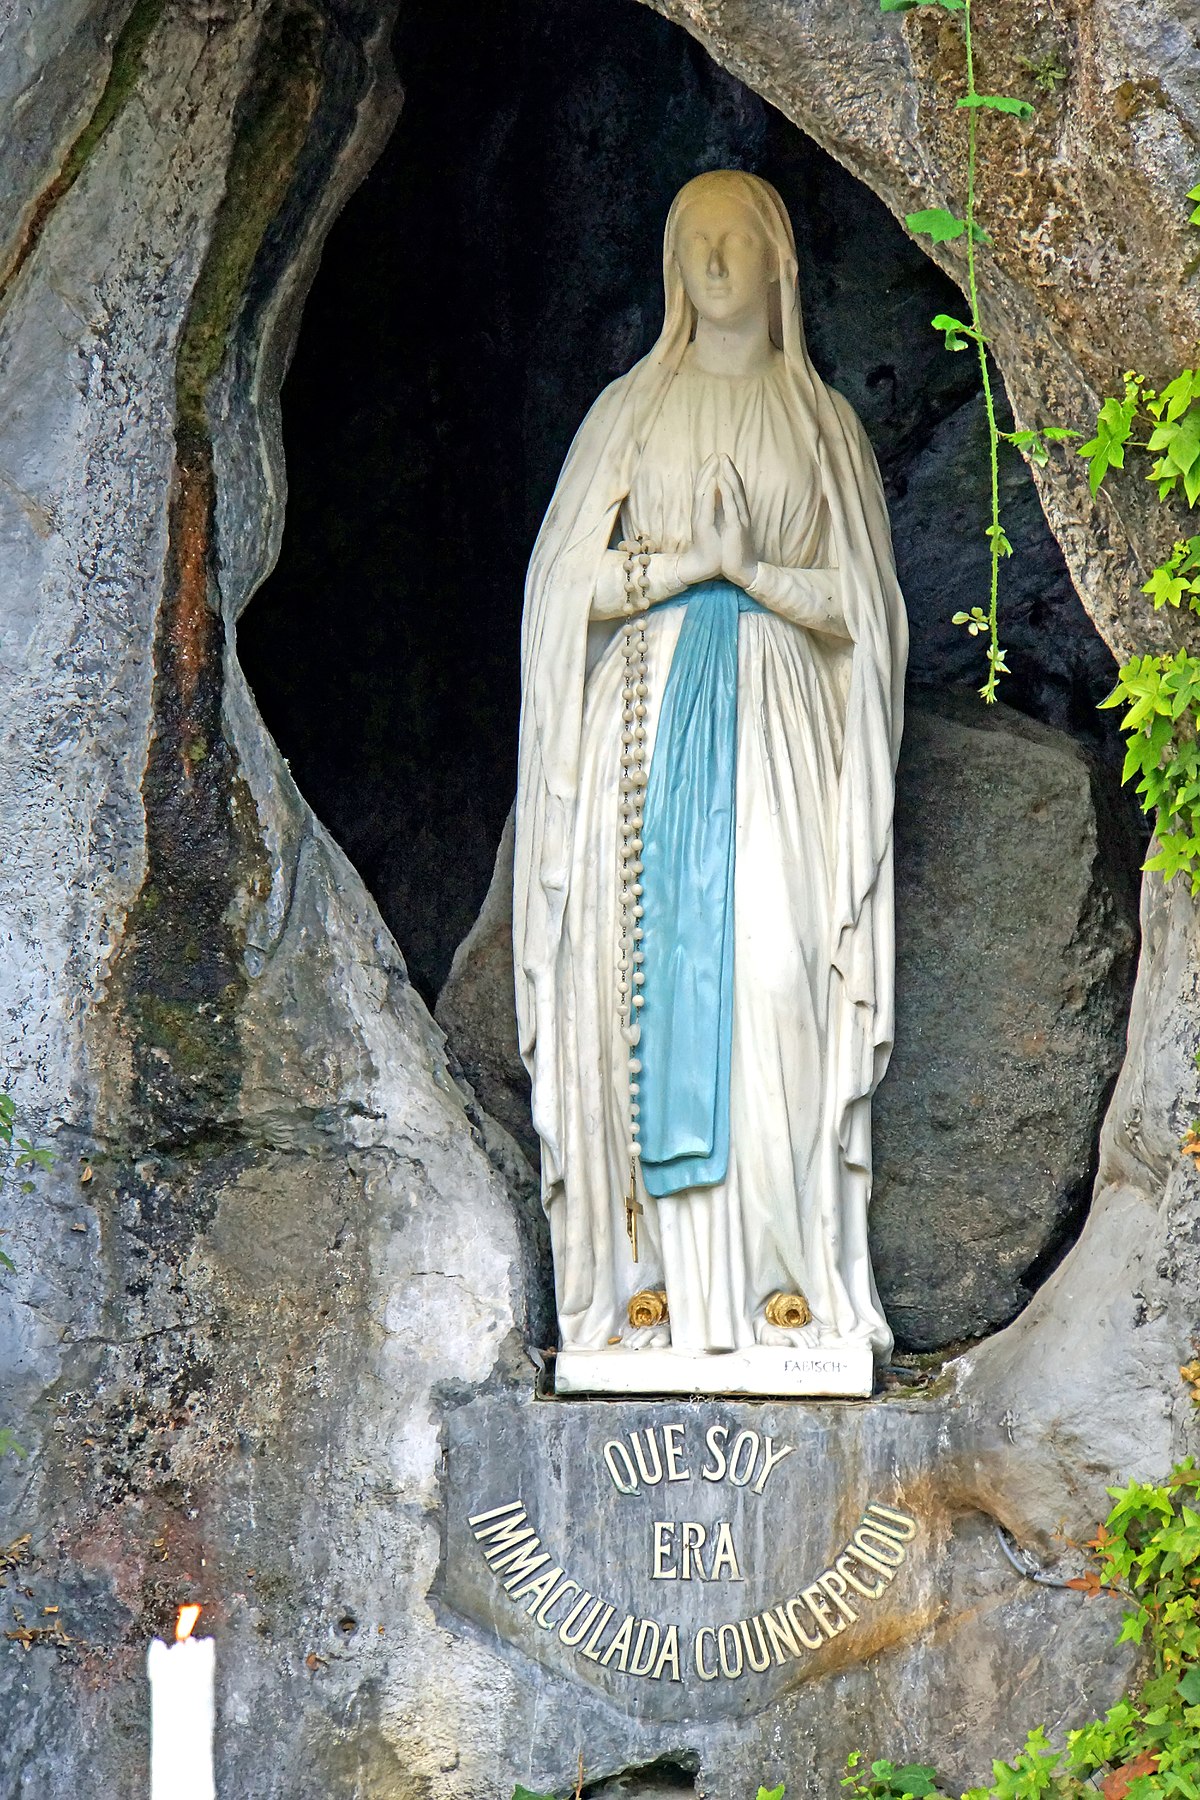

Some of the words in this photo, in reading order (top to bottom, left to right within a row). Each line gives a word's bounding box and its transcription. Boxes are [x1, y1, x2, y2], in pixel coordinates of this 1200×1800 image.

[603, 1424, 690, 1496] QUE
[702, 1425, 797, 1494] SOY
[650, 1522, 744, 1582] ERA
[468, 1500, 681, 1682] IMMACULADA
[695, 1501, 917, 1682] COUNCEPCIOU
